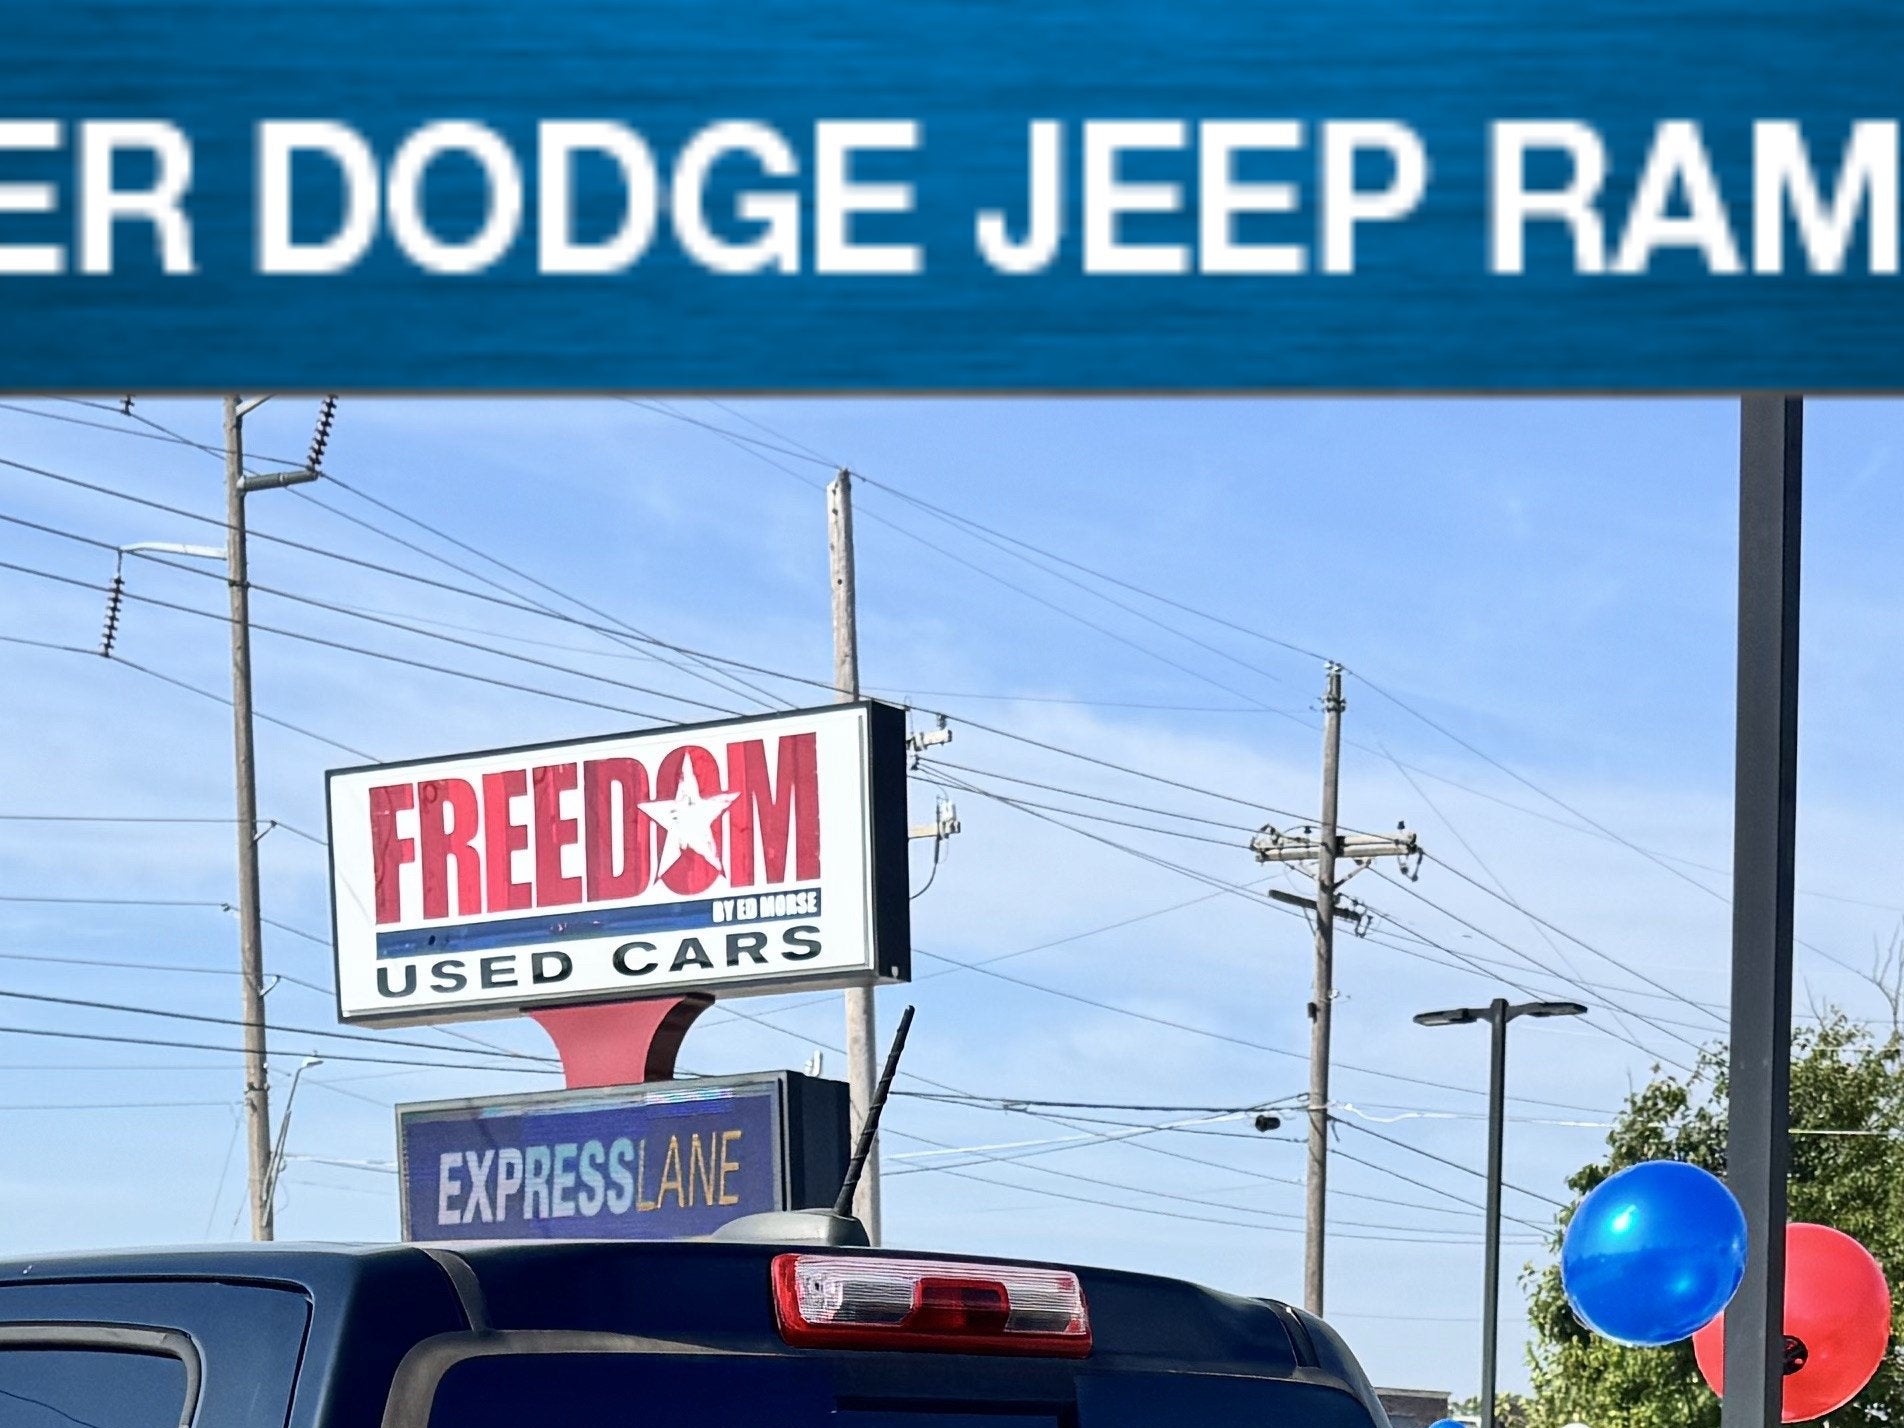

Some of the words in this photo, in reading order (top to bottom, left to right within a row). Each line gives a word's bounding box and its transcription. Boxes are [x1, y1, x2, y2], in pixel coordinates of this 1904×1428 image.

[368, 731, 821, 925] FREEDOM
[712, 898, 734, 923] BY
[736, 896, 758, 921] ED
[759, 891, 818, 918] MORSE
[375, 950, 575, 998] USED
[612, 924, 823, 978] CARS
